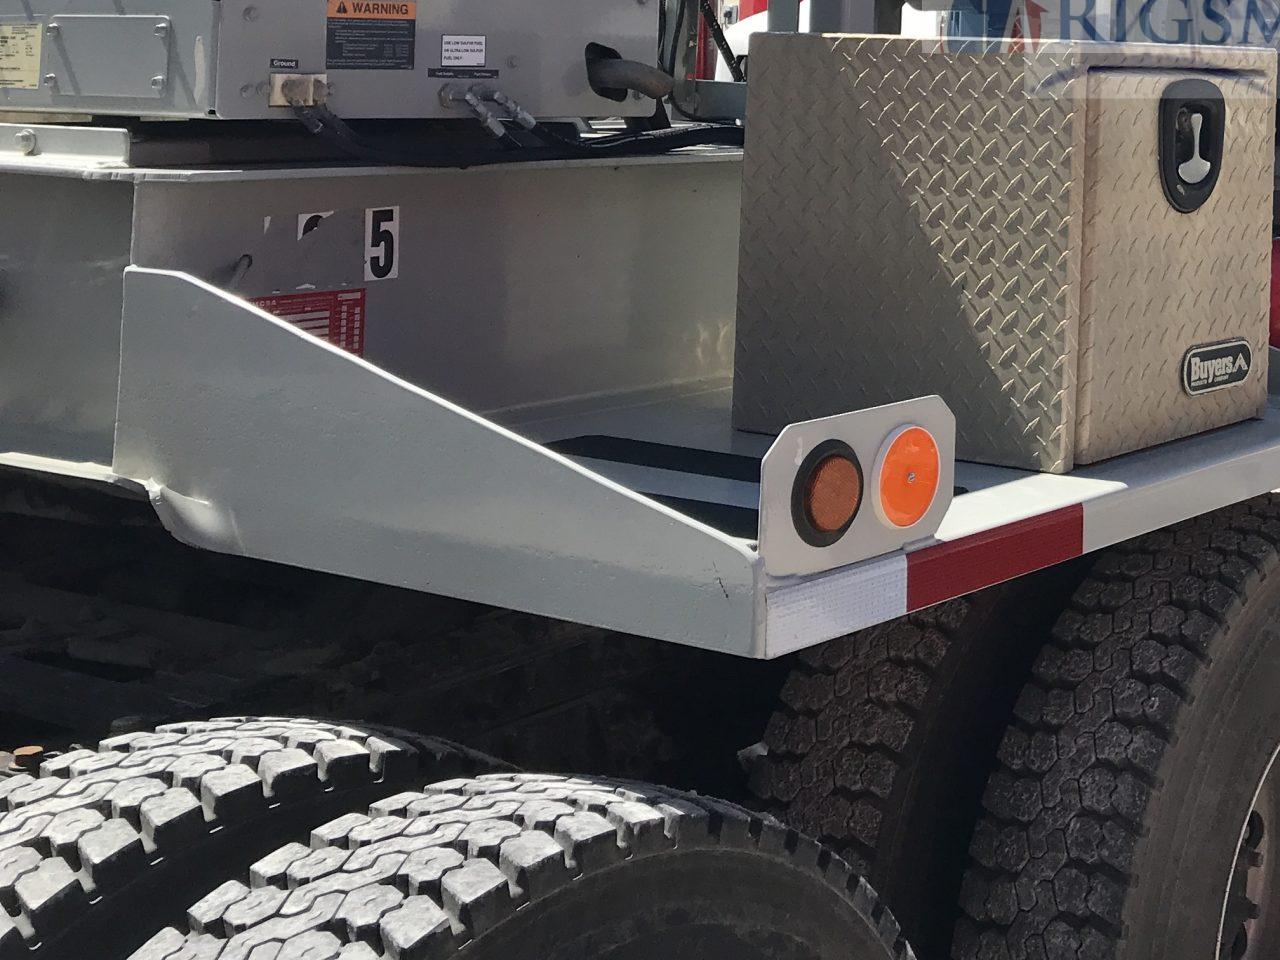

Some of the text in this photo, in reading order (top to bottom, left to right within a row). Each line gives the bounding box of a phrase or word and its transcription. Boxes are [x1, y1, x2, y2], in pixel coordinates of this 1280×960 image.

[352, 2, 409, 15] WARNING
[273, 59, 296, 67] Ground
[370, 209, 394, 278] 5
[1191, 355, 1233, 383] Buyers
